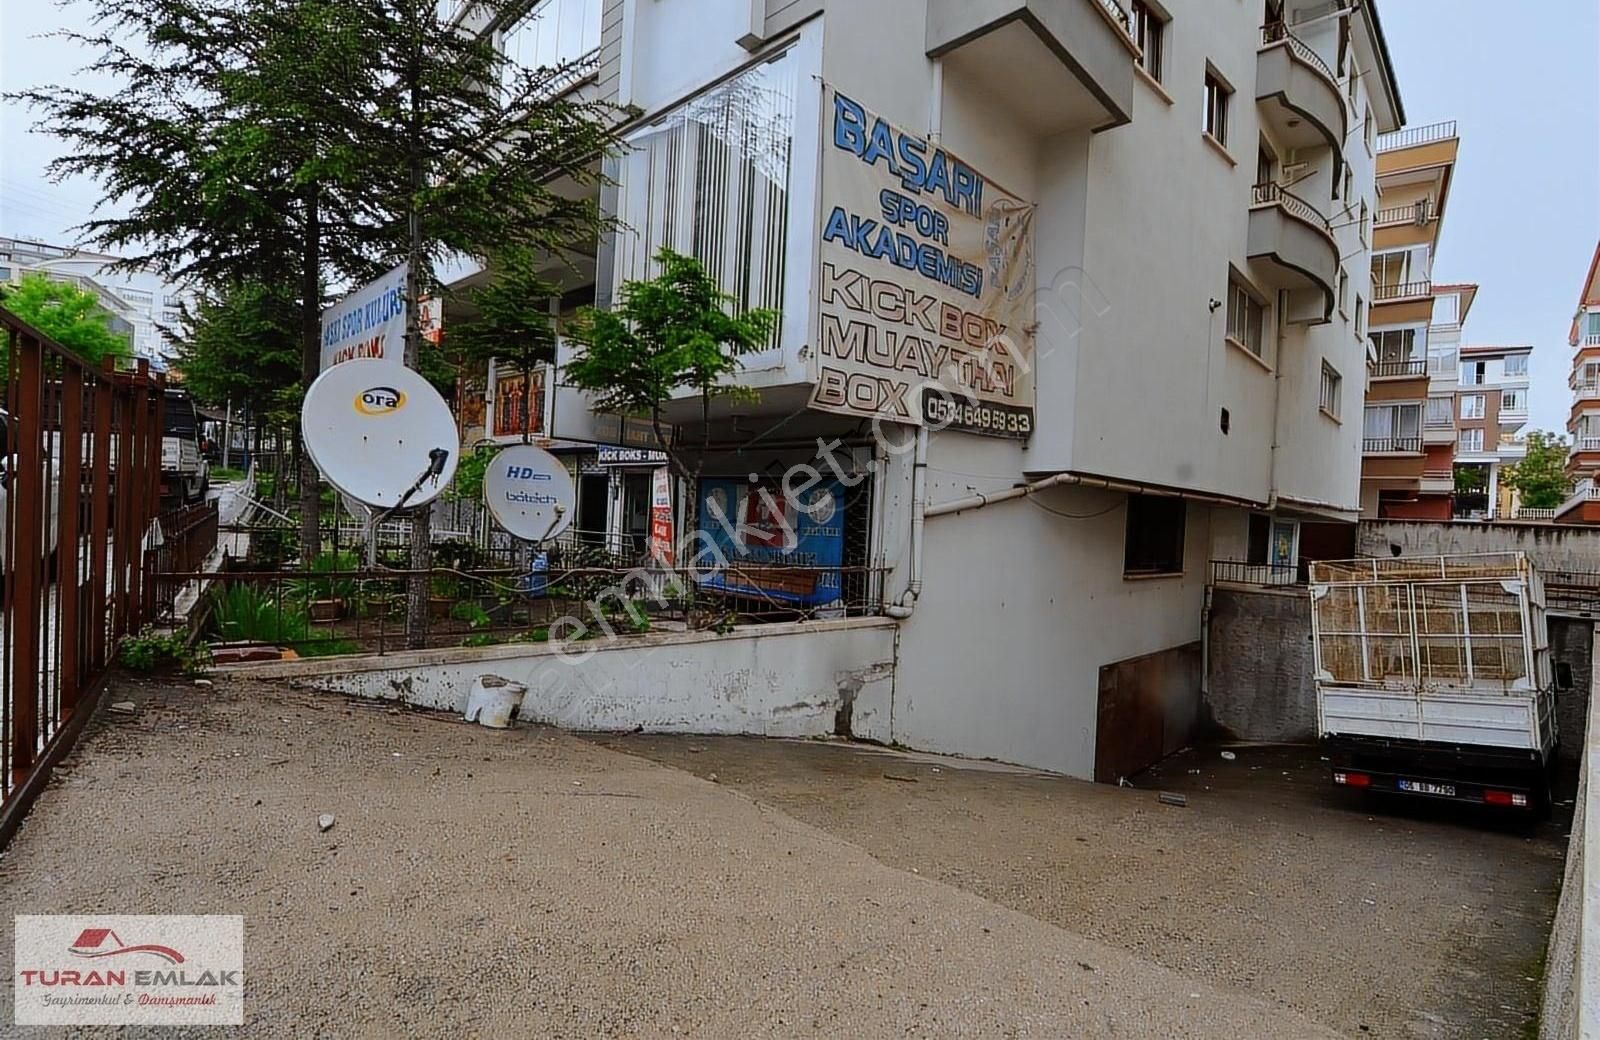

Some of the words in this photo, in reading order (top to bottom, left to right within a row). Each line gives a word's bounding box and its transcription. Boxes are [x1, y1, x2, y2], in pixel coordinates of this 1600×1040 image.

[833, 90, 984, 220] BAŞARI
[880, 188, 949, 246] SPOR
[822, 263, 937, 333] KICK
[940, 302, 1008, 355] BOX
[822, 313, 948, 378] MUAY
[950, 350, 1014, 397] THAI
[362, 393, 398, 409] ora
[815, 367, 910, 417] BOX
[506, 466, 533, 479] HD
